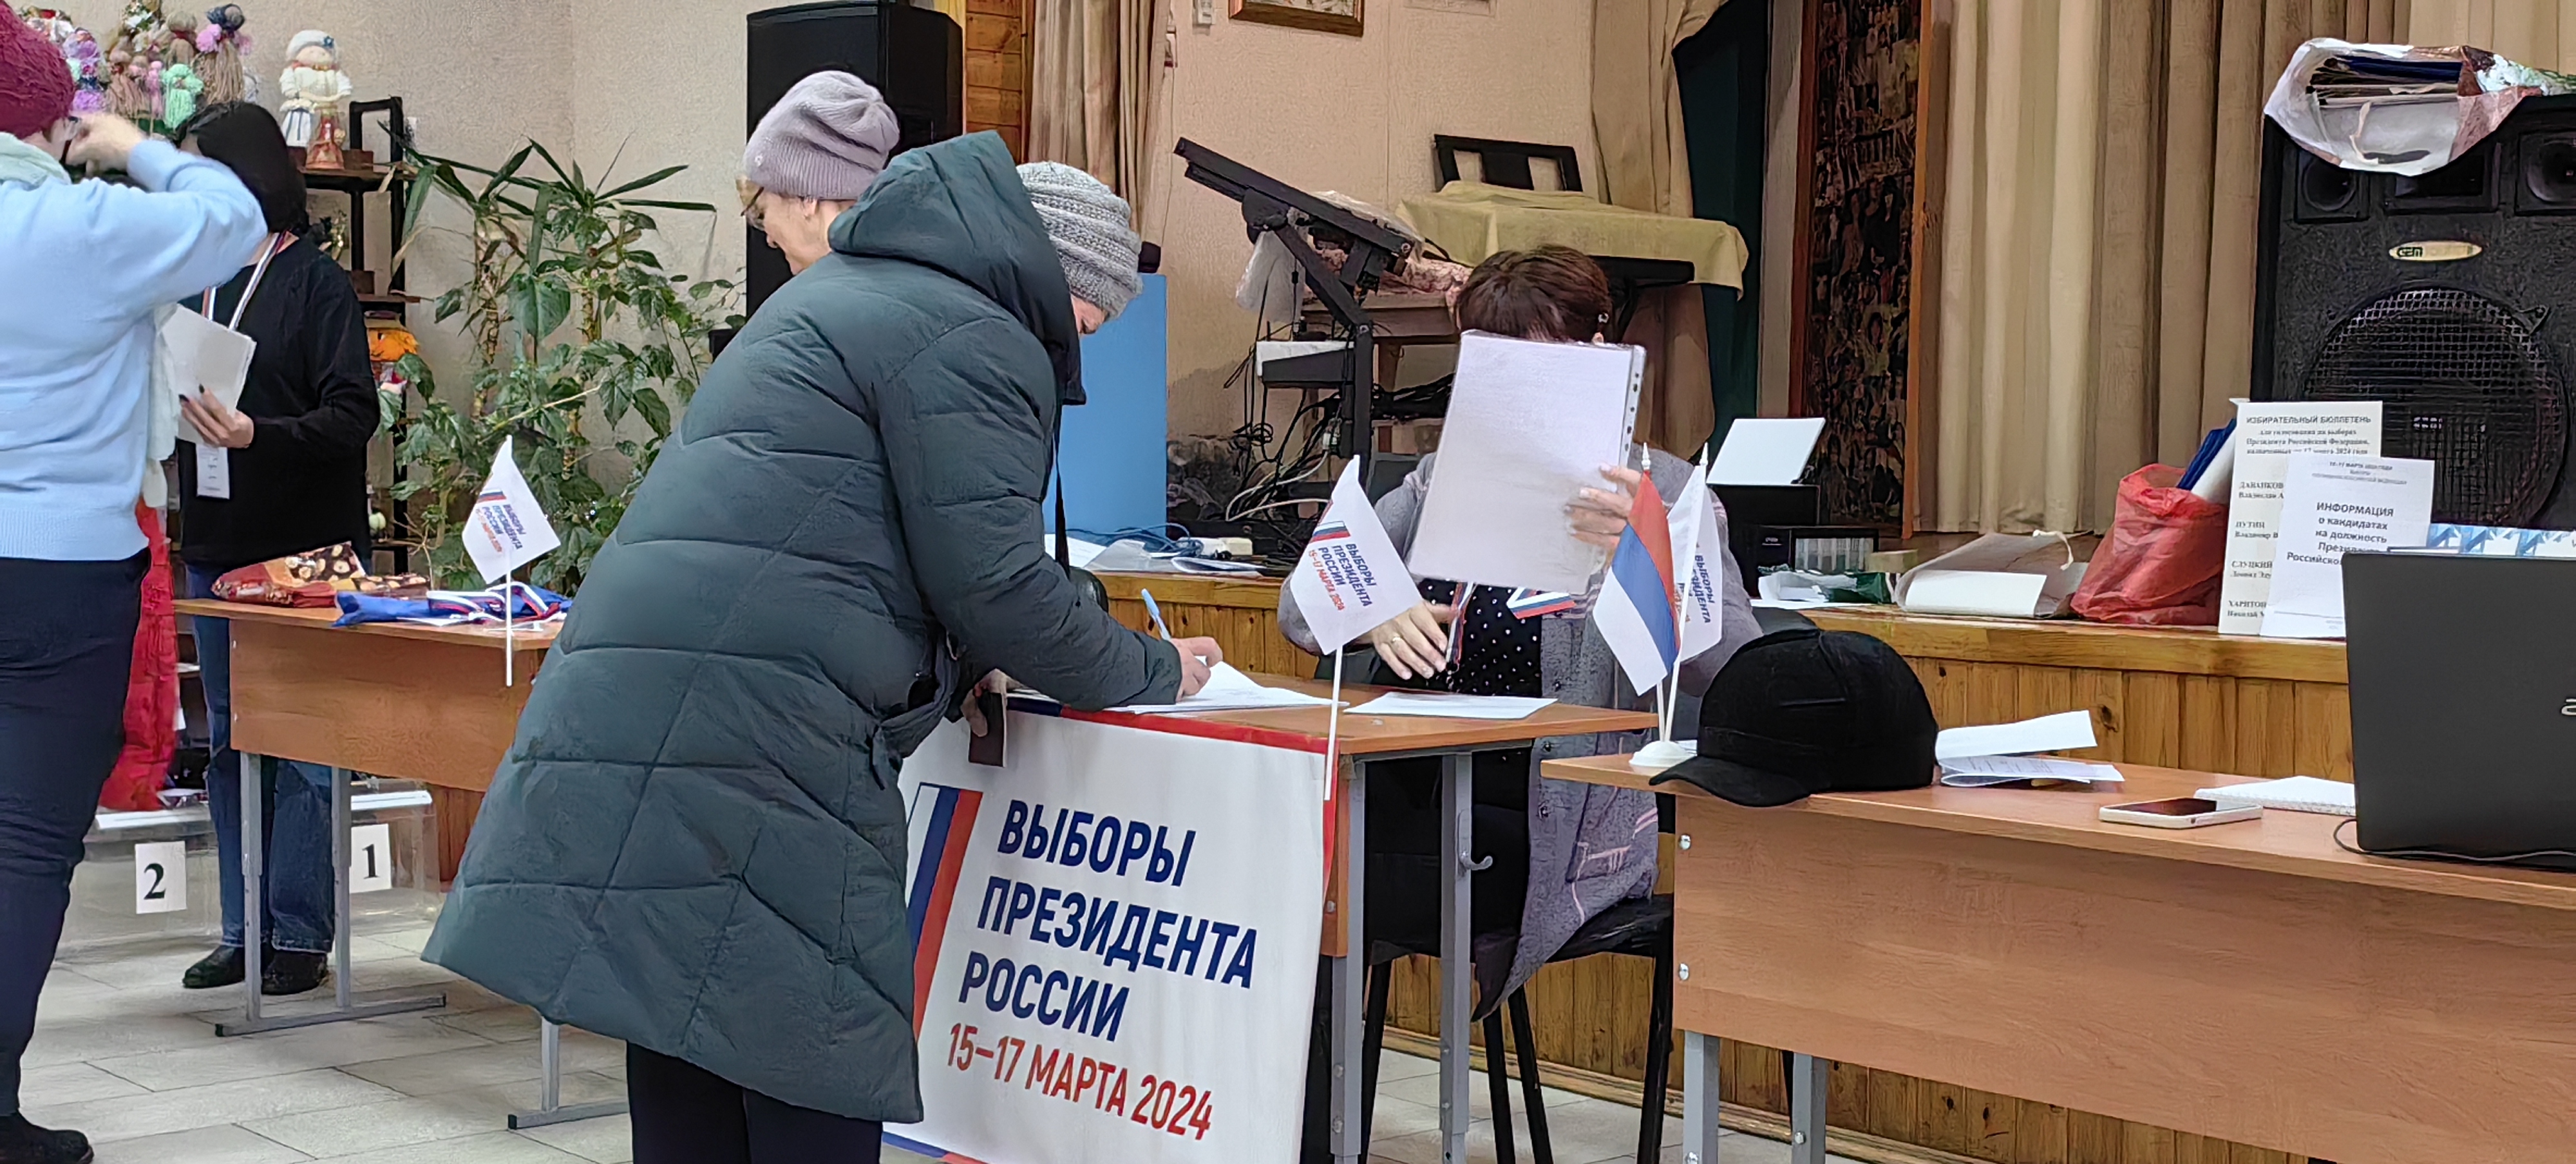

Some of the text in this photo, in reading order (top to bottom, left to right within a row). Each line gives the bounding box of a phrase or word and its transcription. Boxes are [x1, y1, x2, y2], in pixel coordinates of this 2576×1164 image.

[2246, 415, 2318, 424] ИЗБИРАТЕЛЬНЫЙ
[2316, 502, 2394, 517] ИНФОРМАЦИЯ
[2327, 518, 2388, 530] кандидатах
[2330, 532, 2387, 543] должность
[1318, 547, 1346, 585] РОССИИ
[1332, 545, 1372, 606] ПРЕЗИДЕНТА
[1345, 543, 1377, 586] ВЫБОРЫ
[2231, 560, 2273, 568] СЛУЦКИЙ
[2287, 552, 2342, 565] Российско
[1691, 569, 1710, 623] ЗИДЕНТА
[1694, 555, 1715, 604] ВЫБОРЫ
[2228, 600, 2266, 608] ХАРИТОН
[362, 844, 380, 879] 1
[998, 799, 1196, 887] ВЫБОРЫ
[144, 863, 166, 900] 2
[977, 876, 1258, 989] ПРЕЗИДЕНТА
[958, 951, 1130, 1042] РОССИИ
[1025, 1048, 1127, 1116] МАРТА
[1131, 1075, 1212, 1141] 2024
